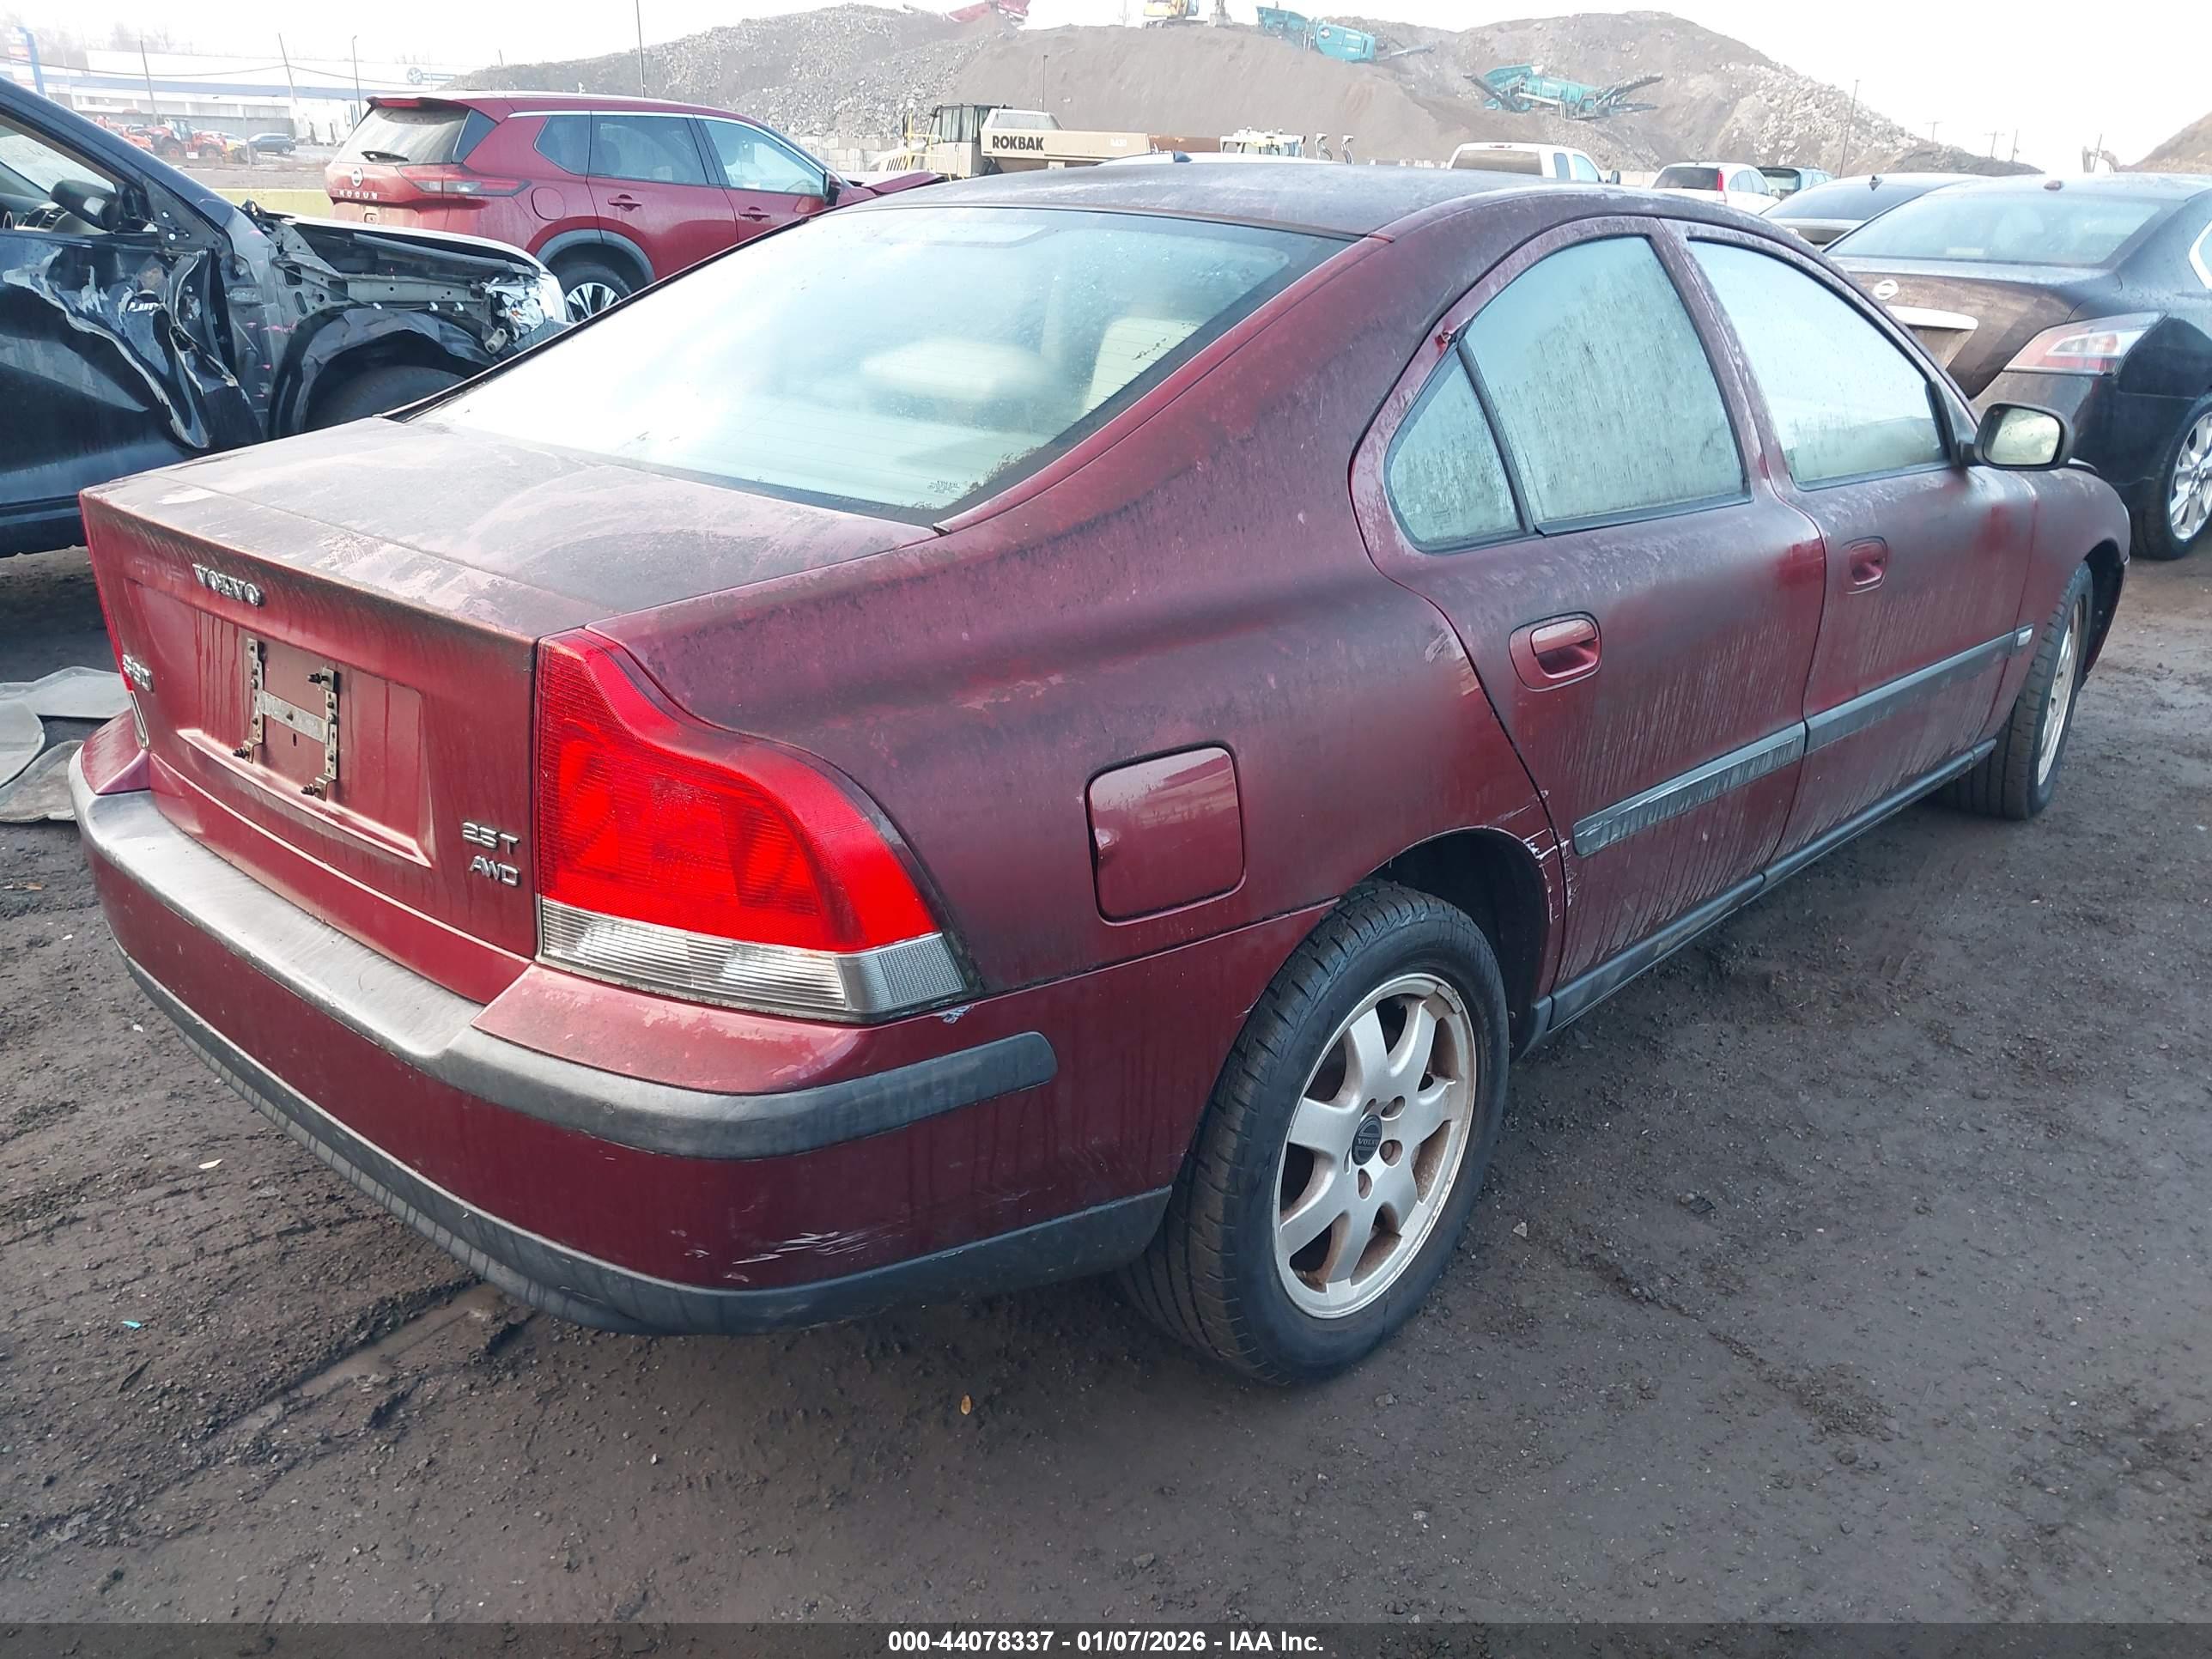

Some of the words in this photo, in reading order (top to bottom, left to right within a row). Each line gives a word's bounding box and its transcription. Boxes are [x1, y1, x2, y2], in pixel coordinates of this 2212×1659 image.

[992, 135, 1044, 151] ROKBAK
[191, 562, 262, 606] VOLVO
[469, 854, 520, 887] AWD
